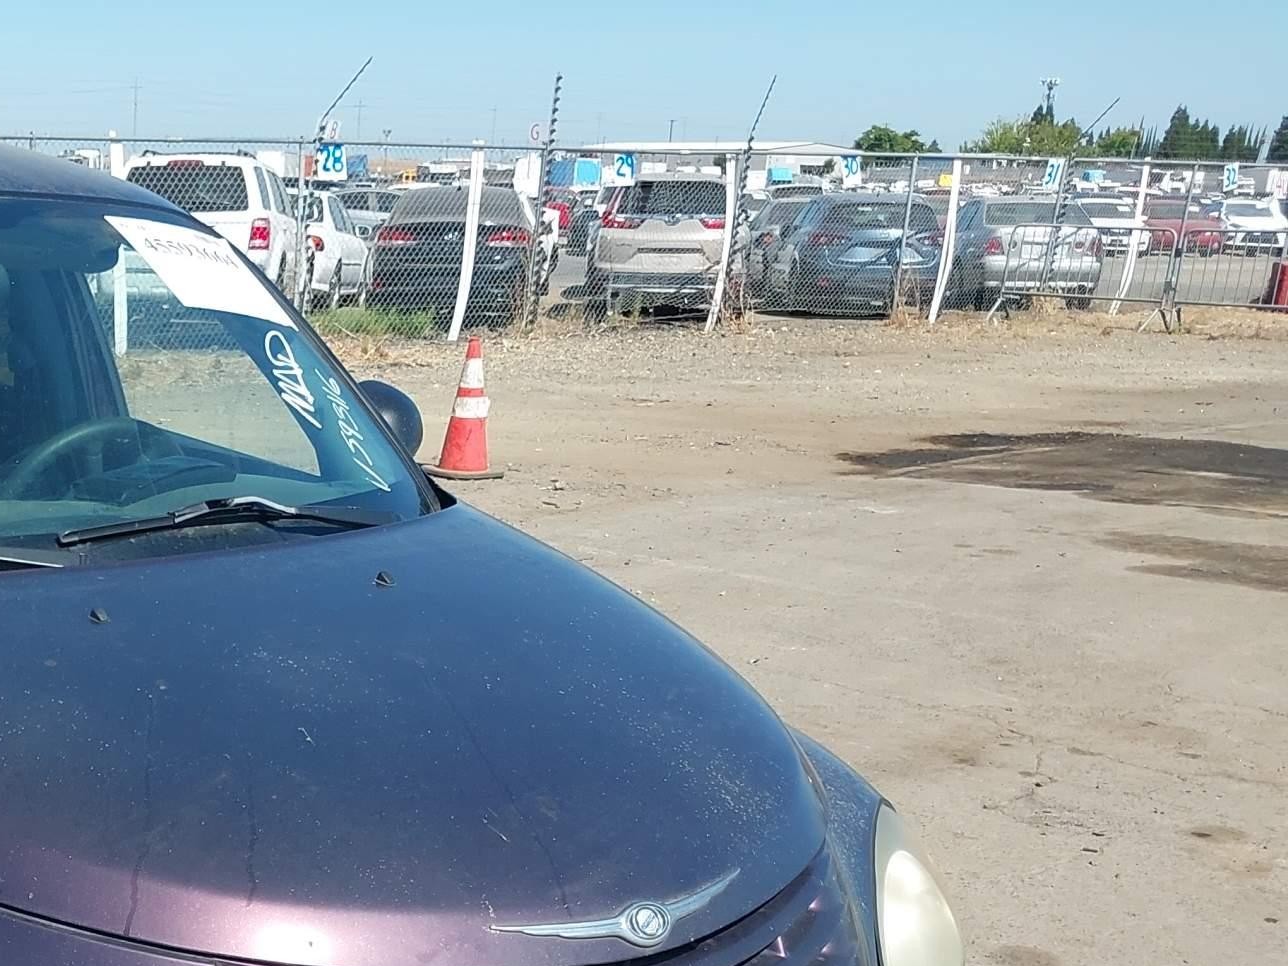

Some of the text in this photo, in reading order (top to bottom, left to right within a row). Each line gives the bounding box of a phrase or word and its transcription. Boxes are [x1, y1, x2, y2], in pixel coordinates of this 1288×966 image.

[317, 143, 344, 173] 28
[615, 151, 634, 180] 29
[841, 155, 859, 178] 30
[1044, 163, 1061, 185] 31
[1224, 167, 1238, 188] 32
